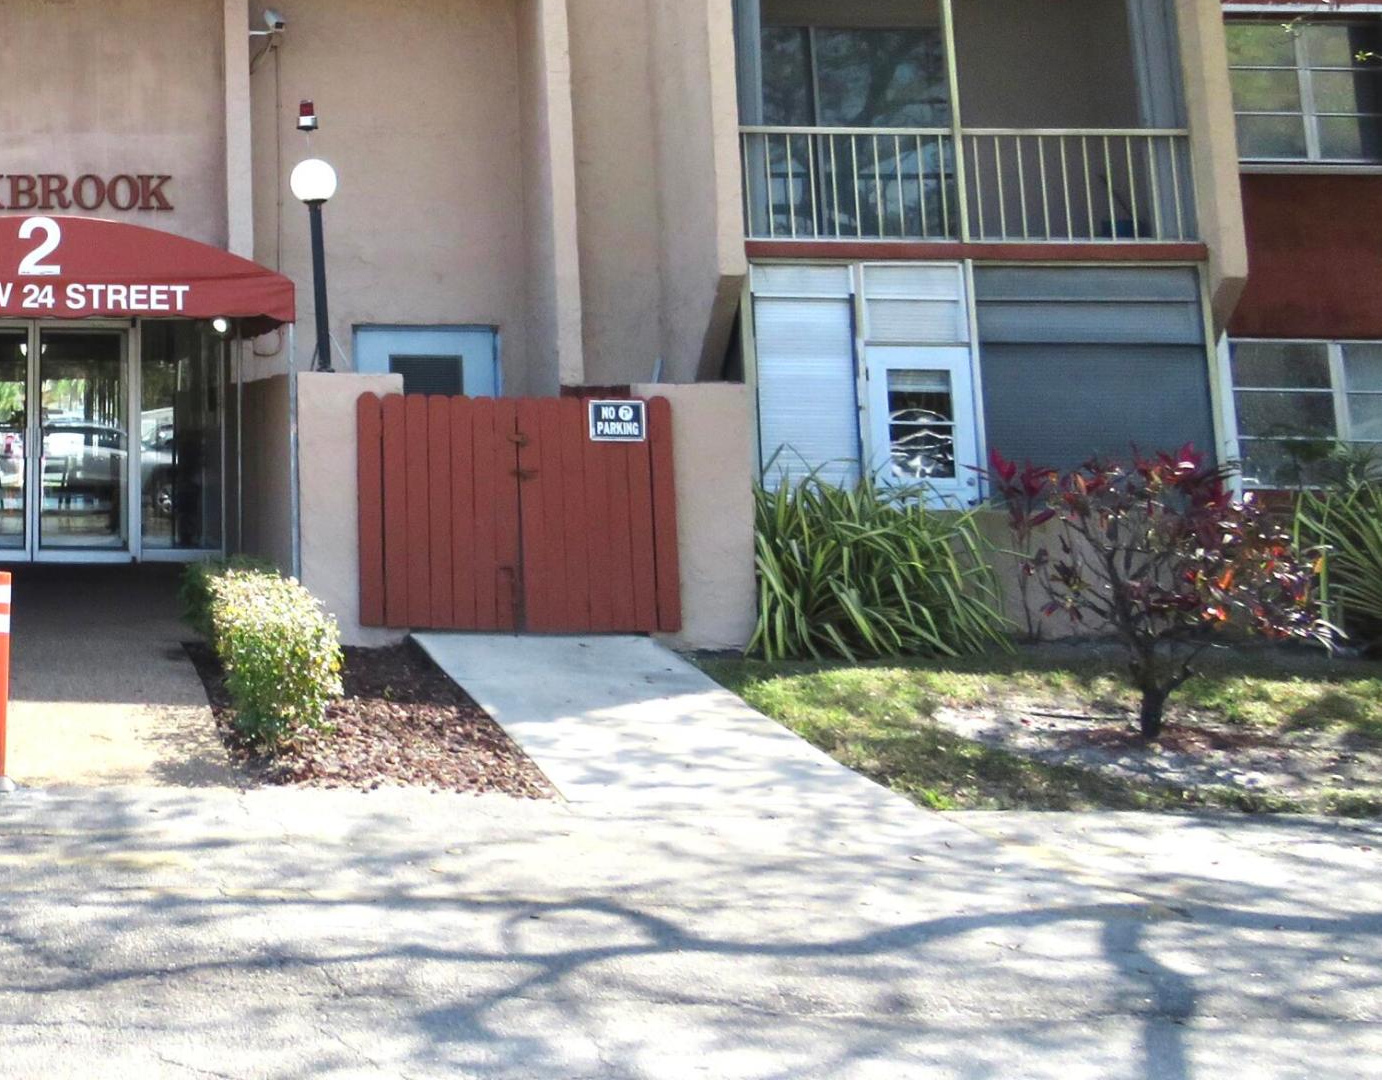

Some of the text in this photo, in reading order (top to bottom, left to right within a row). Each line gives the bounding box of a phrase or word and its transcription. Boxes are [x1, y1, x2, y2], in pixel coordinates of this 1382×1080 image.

[18, 216, 61, 276] 2
[22, 284, 55, 308] 24
[65, 283, 190, 311] STREET
[601, 406, 616, 419] NO
[597, 422, 639, 435] PARKING
